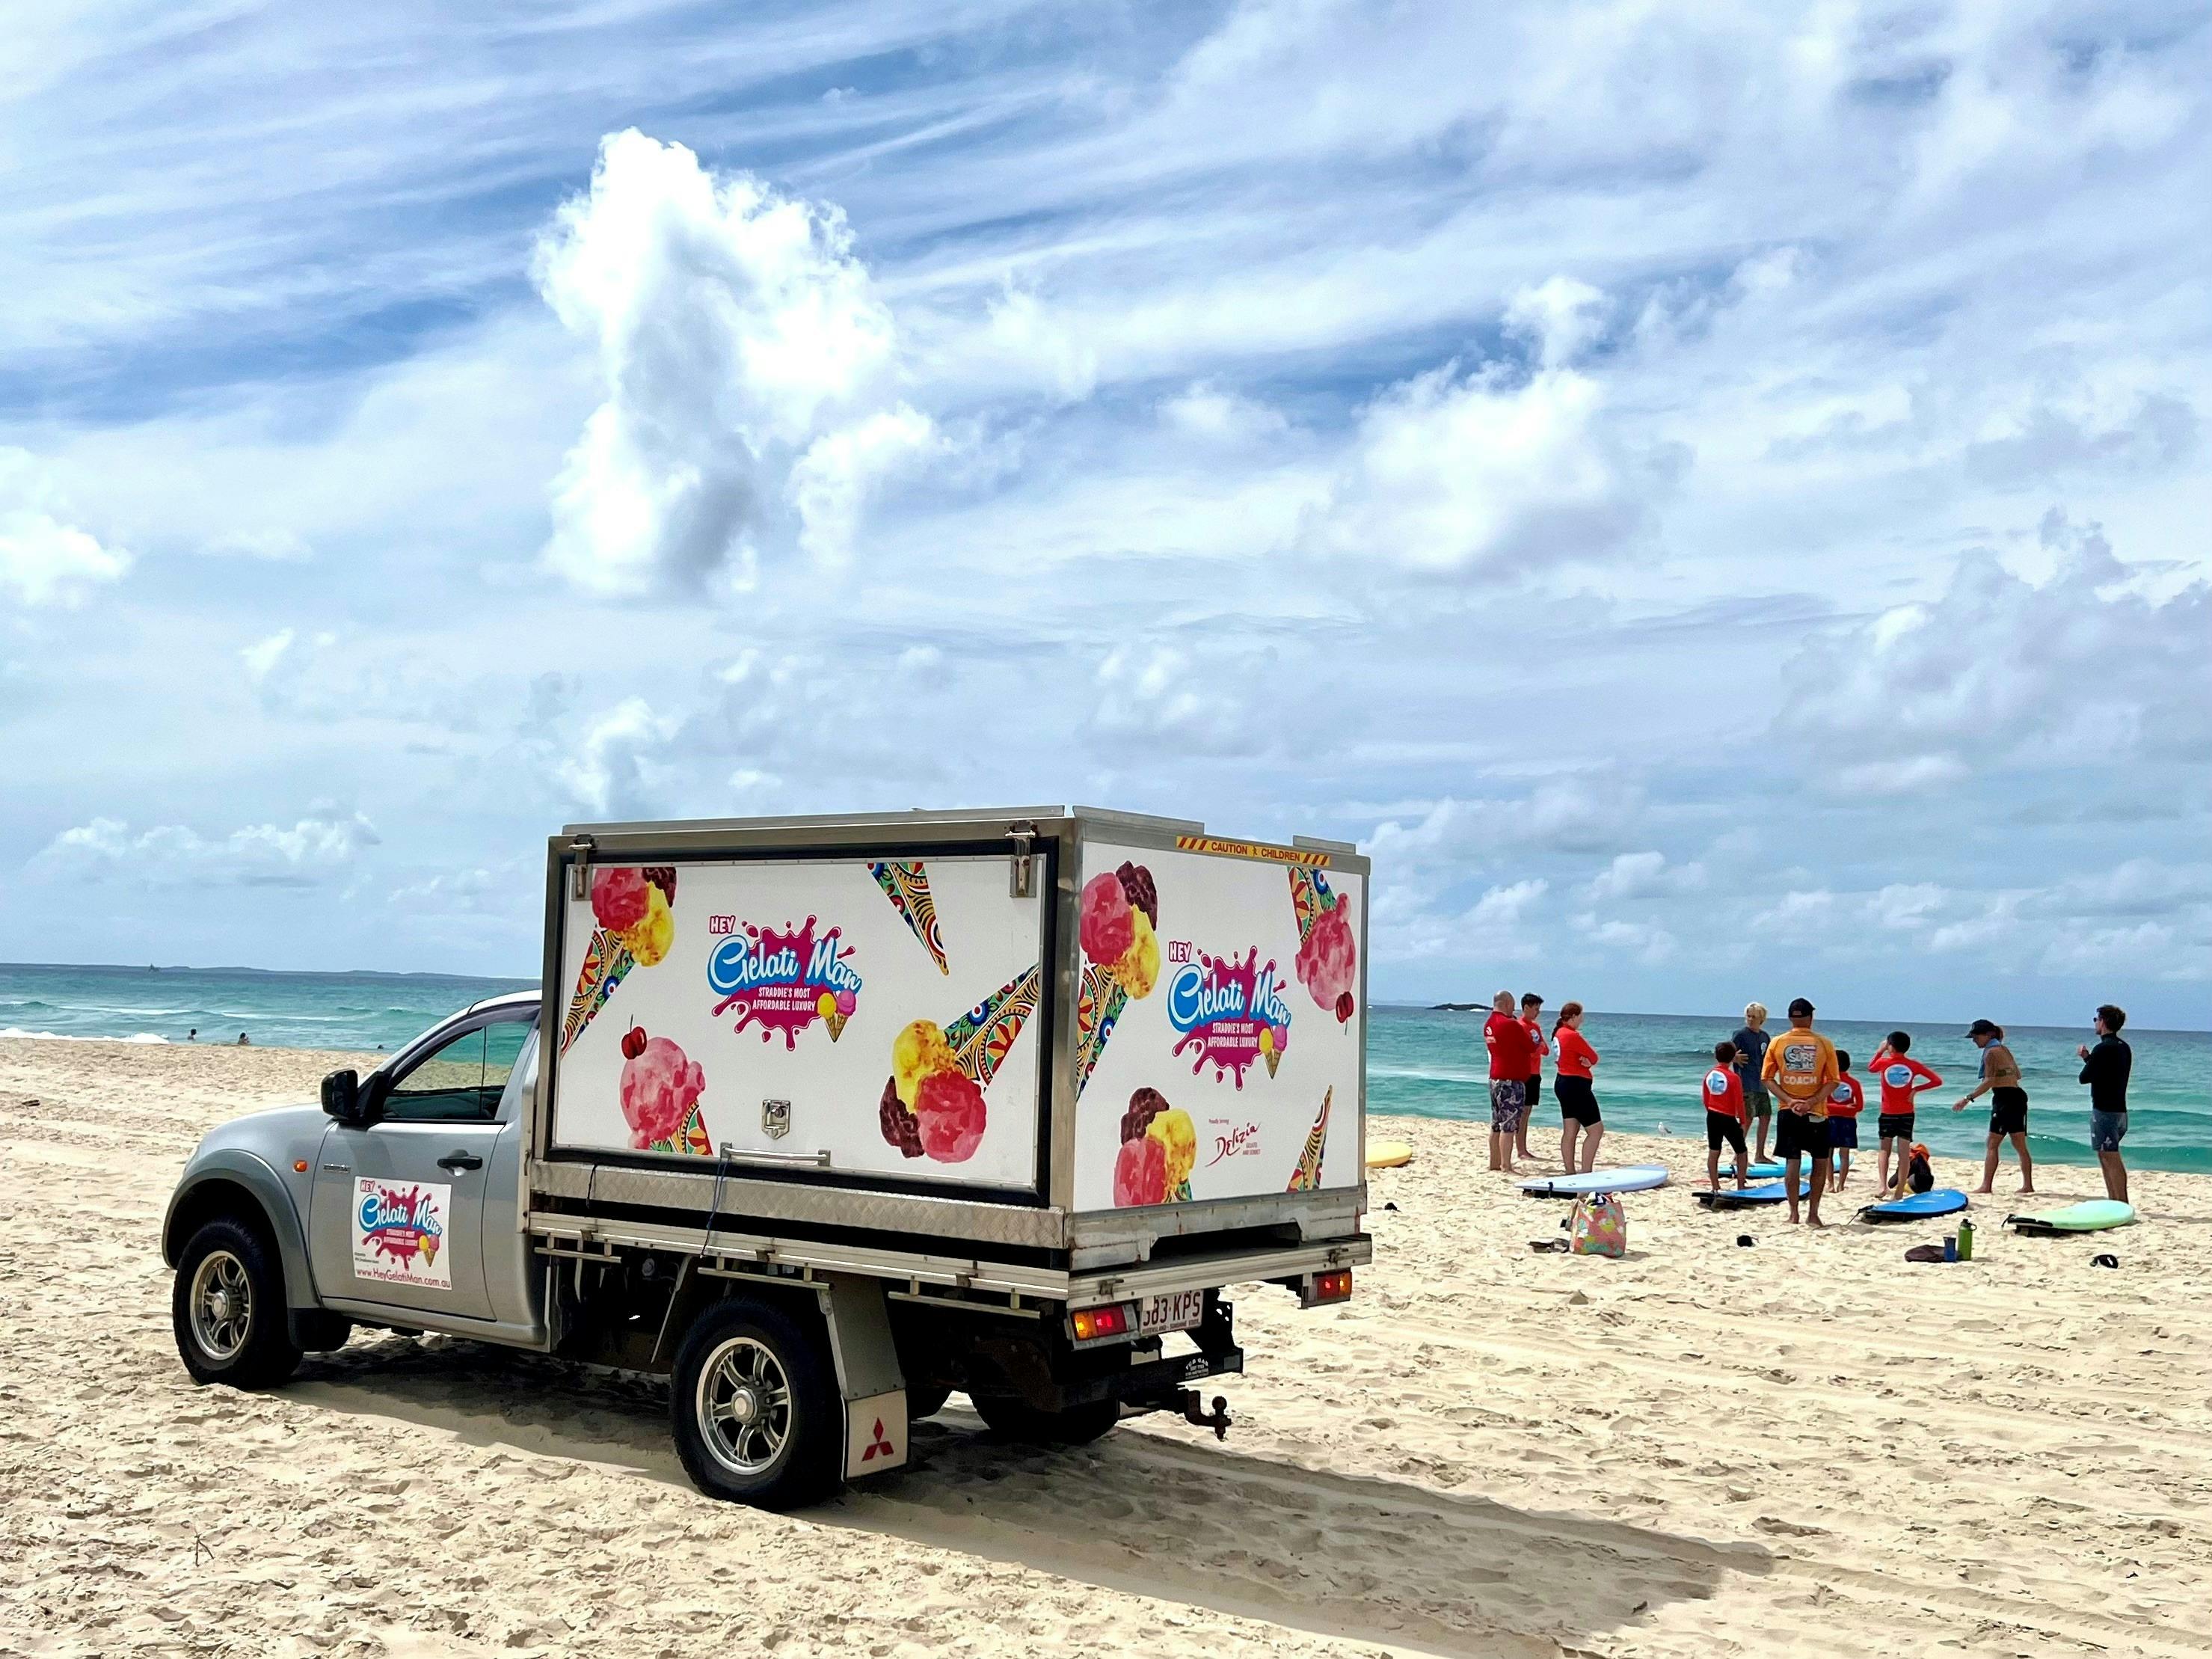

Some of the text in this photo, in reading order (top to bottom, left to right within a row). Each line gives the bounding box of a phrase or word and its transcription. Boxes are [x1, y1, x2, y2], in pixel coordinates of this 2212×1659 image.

[1211, 842, 1300, 861] CAUTION CHILDREN
[710, 916, 735, 933] HEY
[1169, 942, 1191, 962] HEY
[708, 935, 862, 991] Gelati Man
[758, 987, 811, 998] STRADDIE'S MOST
[1169, 965, 1292, 1025] Gelati Man
[752, 999, 816, 1011] AFFORDABLE LUXURY
[1208, 1037, 1238, 1047] AFFORDABLE
[1784, 1076, 1817, 1085] COACH
[360, 1180, 375, 1192] HEY
[359, 1193, 443, 1235] Gelati Man
[356, 1267, 451, 1287] www.HeyGelatiMan.com.au
